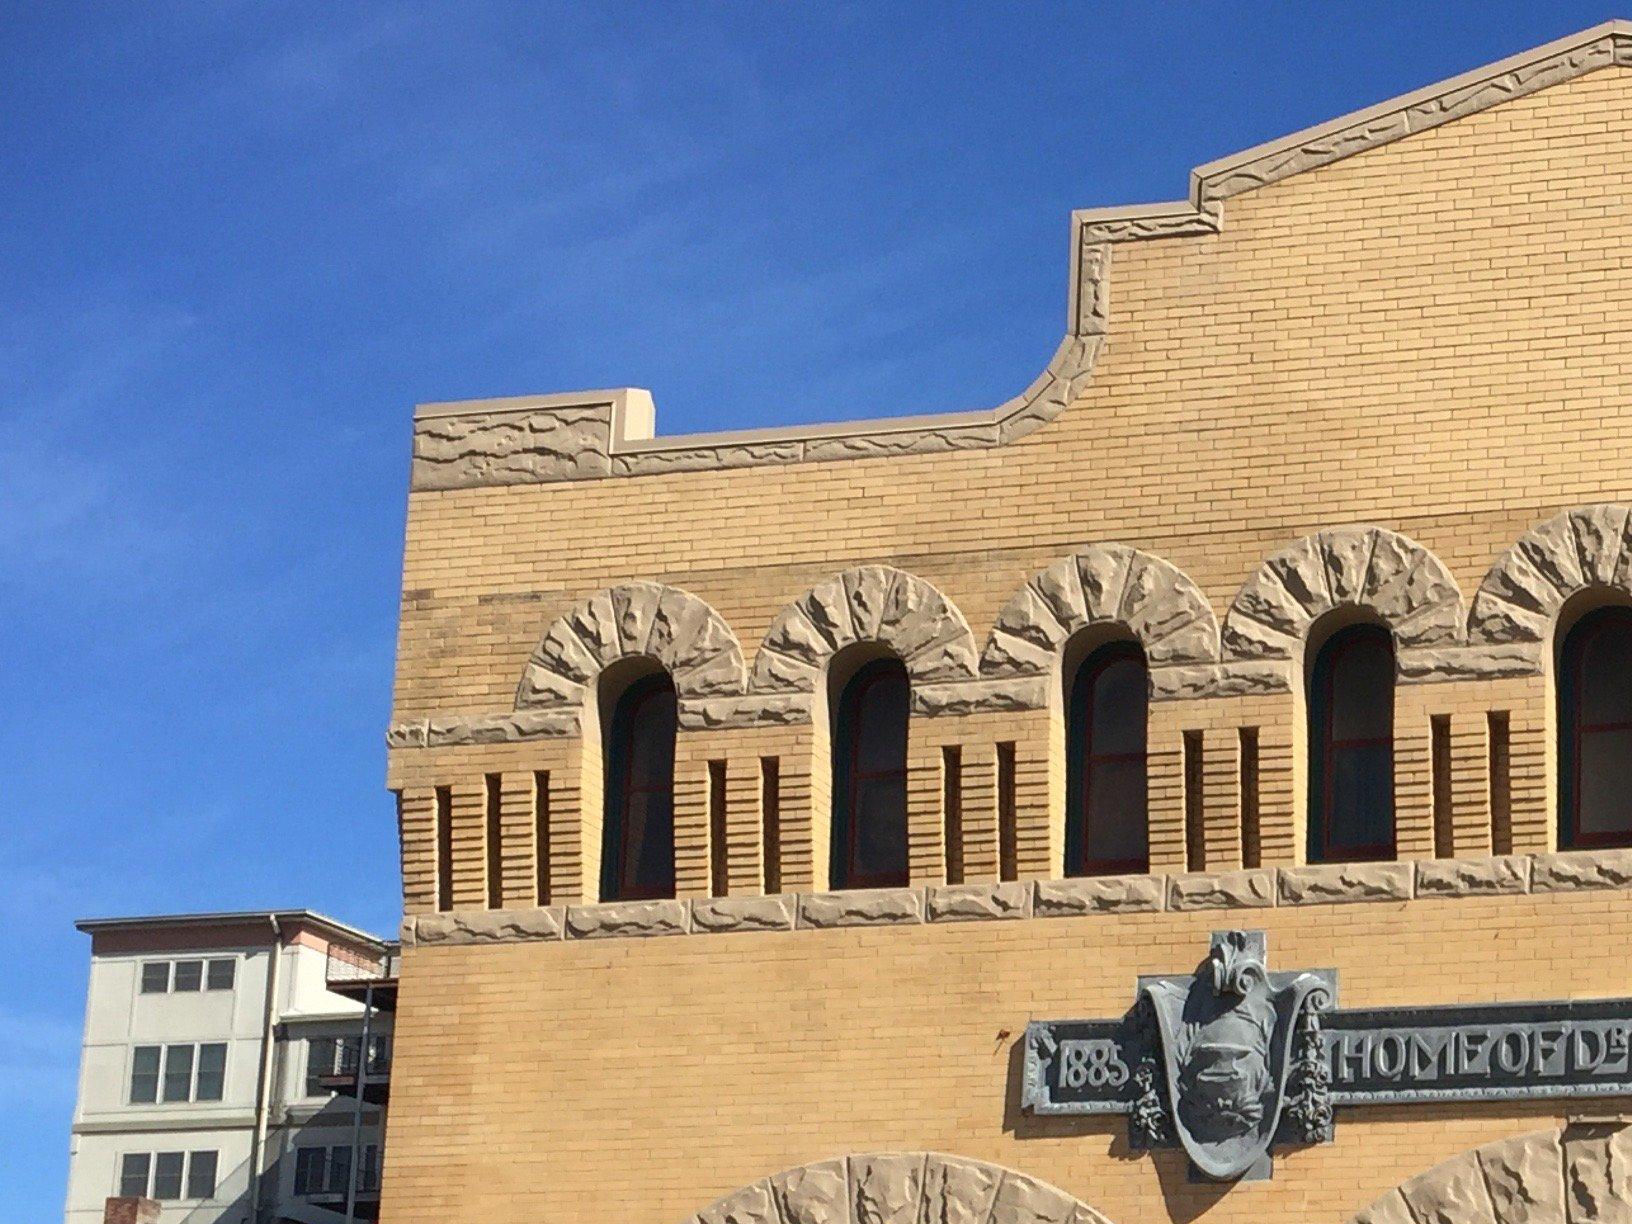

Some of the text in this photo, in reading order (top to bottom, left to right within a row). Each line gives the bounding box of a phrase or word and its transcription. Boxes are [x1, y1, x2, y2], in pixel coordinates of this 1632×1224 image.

[1058, 1041, 1130, 1088] 1885
[1338, 1028, 1494, 1082] HOME
[1497, 1025, 1569, 1077] OF
